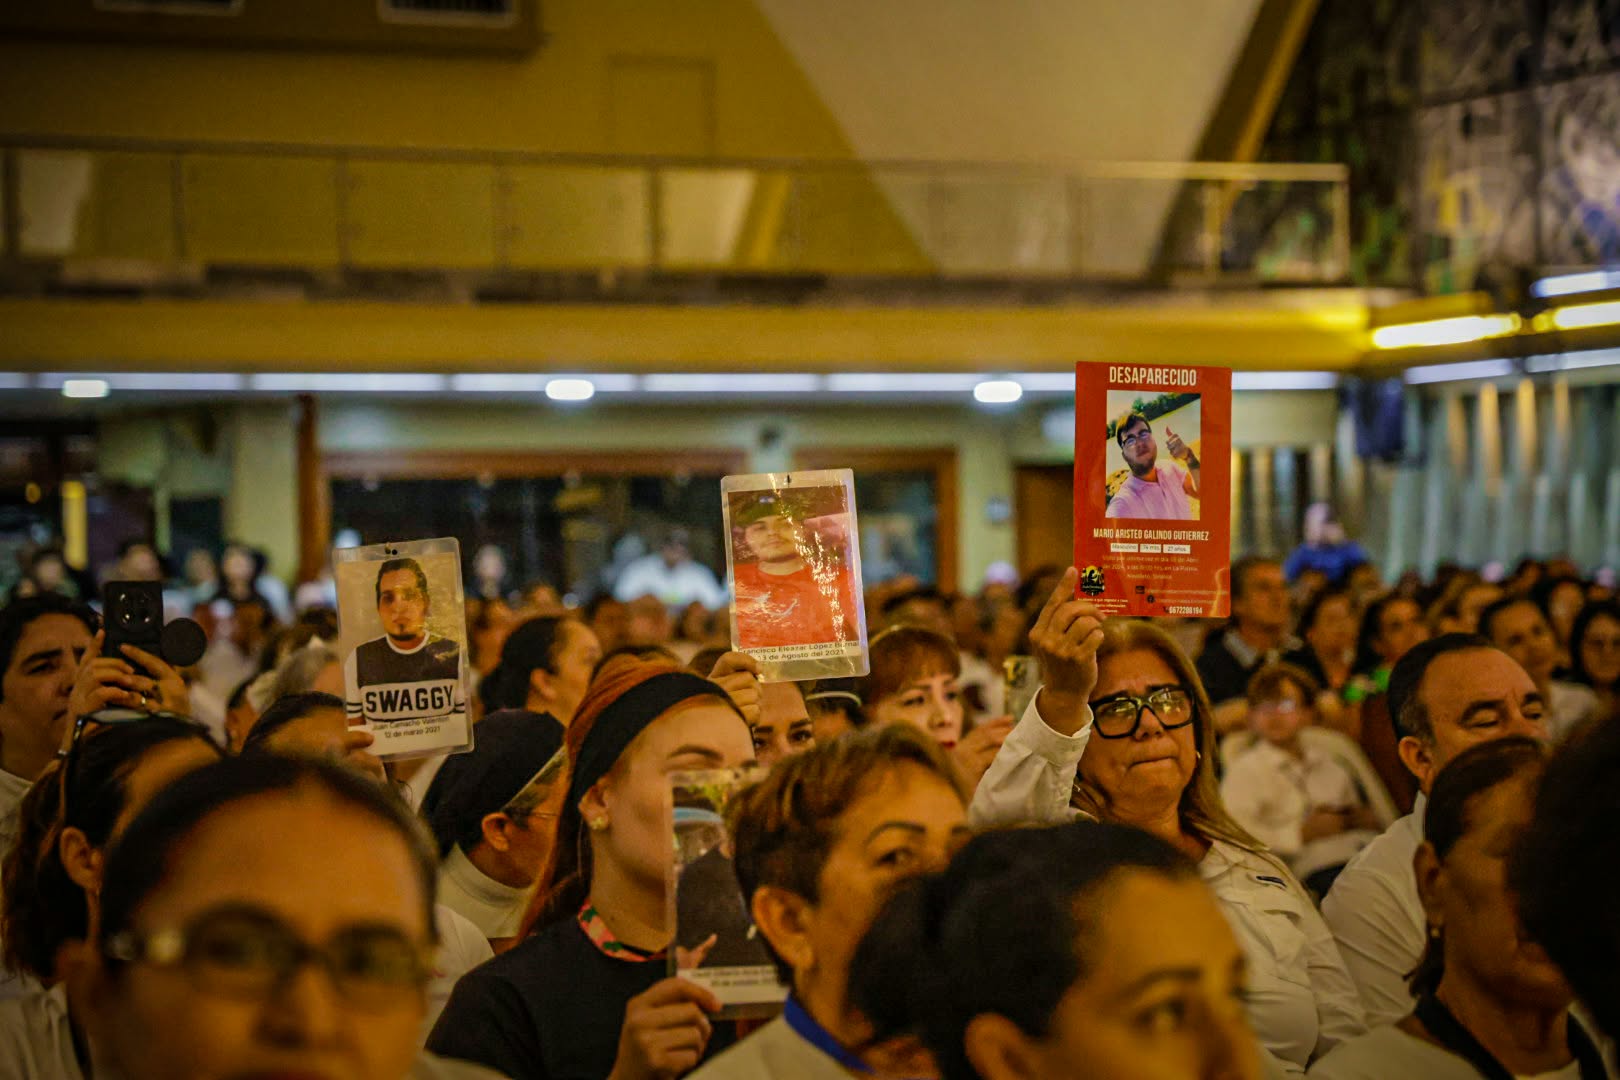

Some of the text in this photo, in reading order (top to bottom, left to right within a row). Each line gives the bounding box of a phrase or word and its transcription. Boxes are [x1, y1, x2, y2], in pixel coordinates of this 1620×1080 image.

[1109, 366, 1197, 386] DESAPARECIDO
[1093, 528, 1209, 541] MARIO ARISTEO GALINDO GUTIERREZ
[809, 643, 832, 651] López
[781, 652, 808, 660] Agosto
[365, 685, 453, 713] SWAGGY
[403, 728, 423, 736] marzo
[425, 726, 441, 734] 2021
